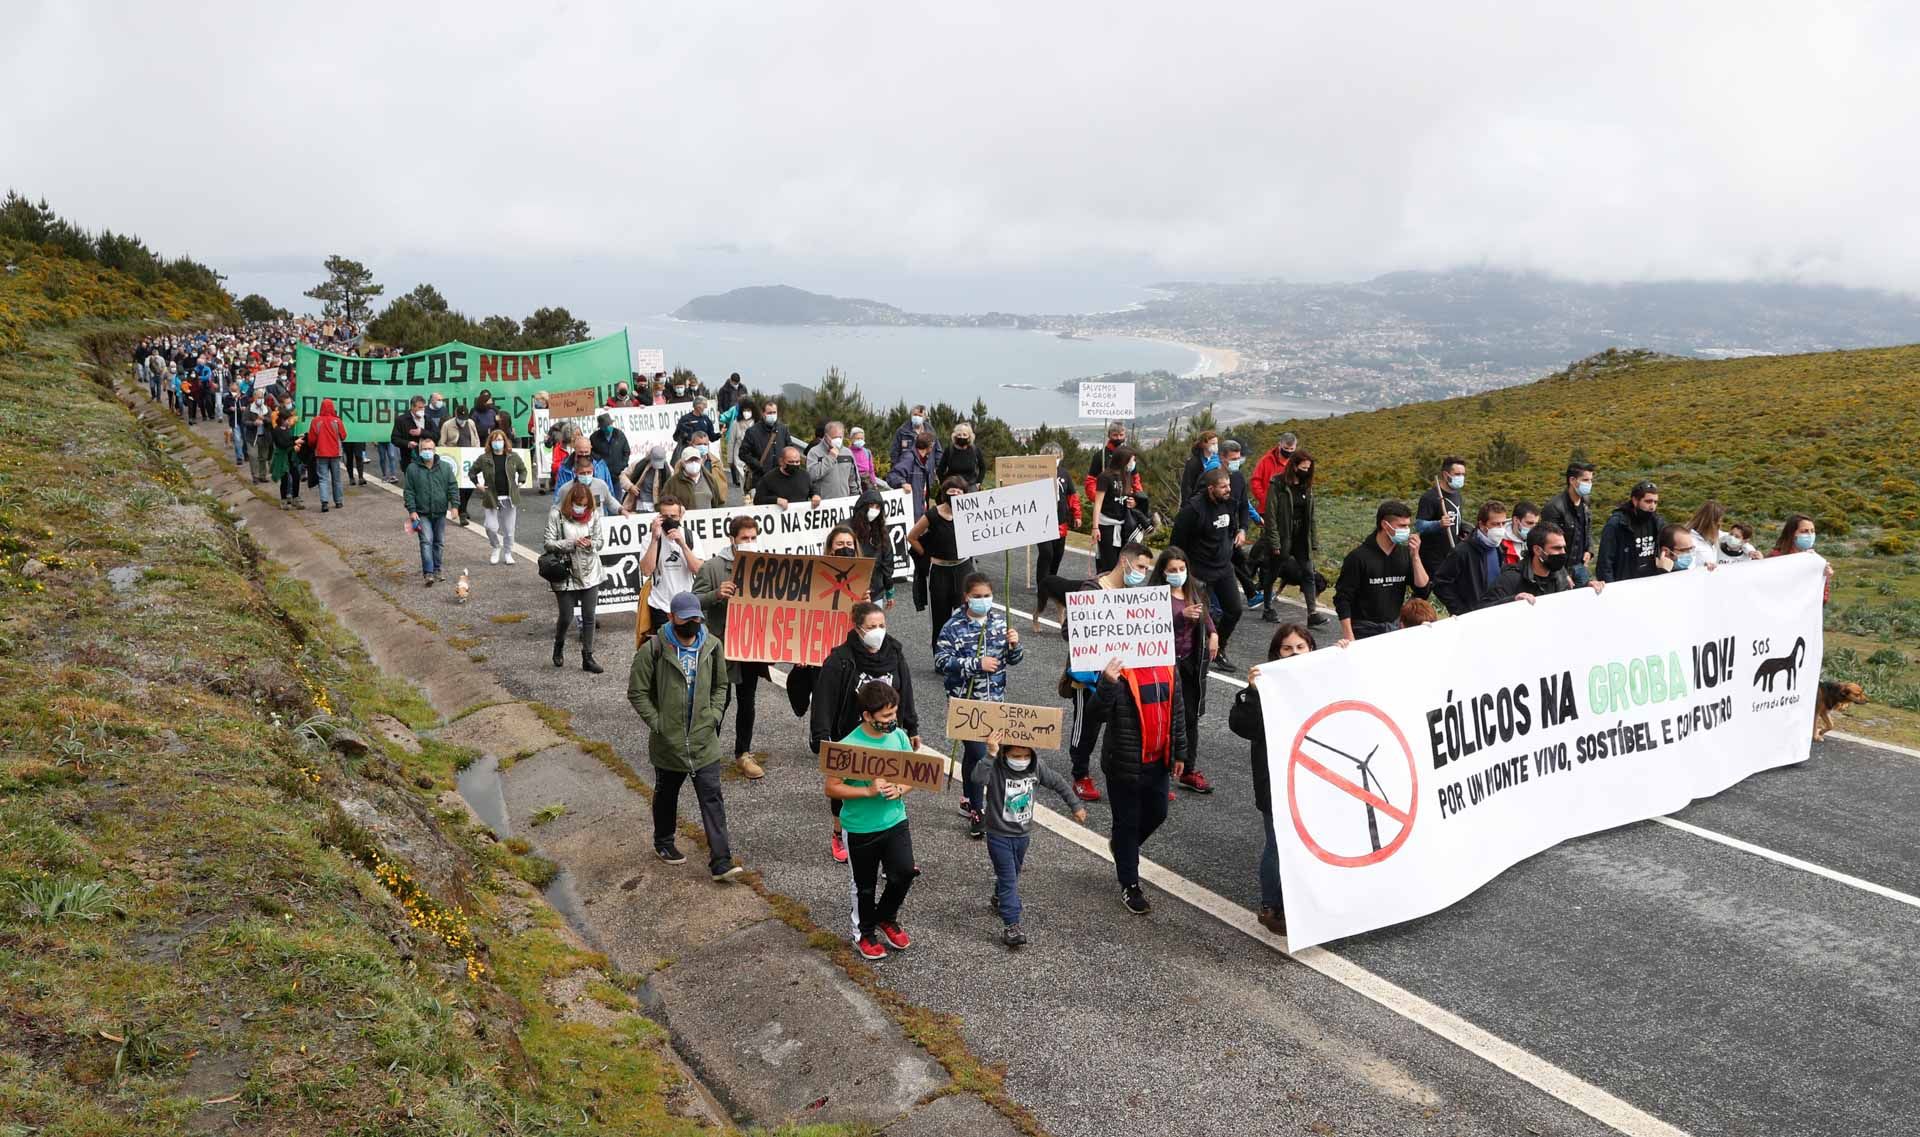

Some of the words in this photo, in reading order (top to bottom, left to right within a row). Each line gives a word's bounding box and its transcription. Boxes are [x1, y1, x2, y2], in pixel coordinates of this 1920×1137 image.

[318, 351, 467, 385] EOLICOS
[956, 496, 979, 512] NON
[966, 500, 1037, 524] PANDEMIA
[608, 524, 632, 547] AO
[781, 513, 801, 534] NA
[750, 556, 814, 602] GROBA
[1069, 594, 1095, 606] NON
[727, 603, 768, 660] NON
[770, 606, 796, 661] SE
[1752, 637, 1770, 657] SOS
[1137, 640, 1168, 657] NON
[955, 706, 994, 738] SOS
[999, 704, 1038, 719] SERRA
[1008, 719, 1026, 729] DA
[1426, 682, 1531, 770] EÓLICOS
[1540, 670, 1579, 730] NA
[1587, 650, 1688, 715] GROBA
[903, 759, 940, 785] NON
[1438, 781, 1466, 820] POR
[1467, 772, 1485, 806] UN
[1576, 719, 1658, 764] SOSTÍBEL
[1661, 718, 1674, 745] E
